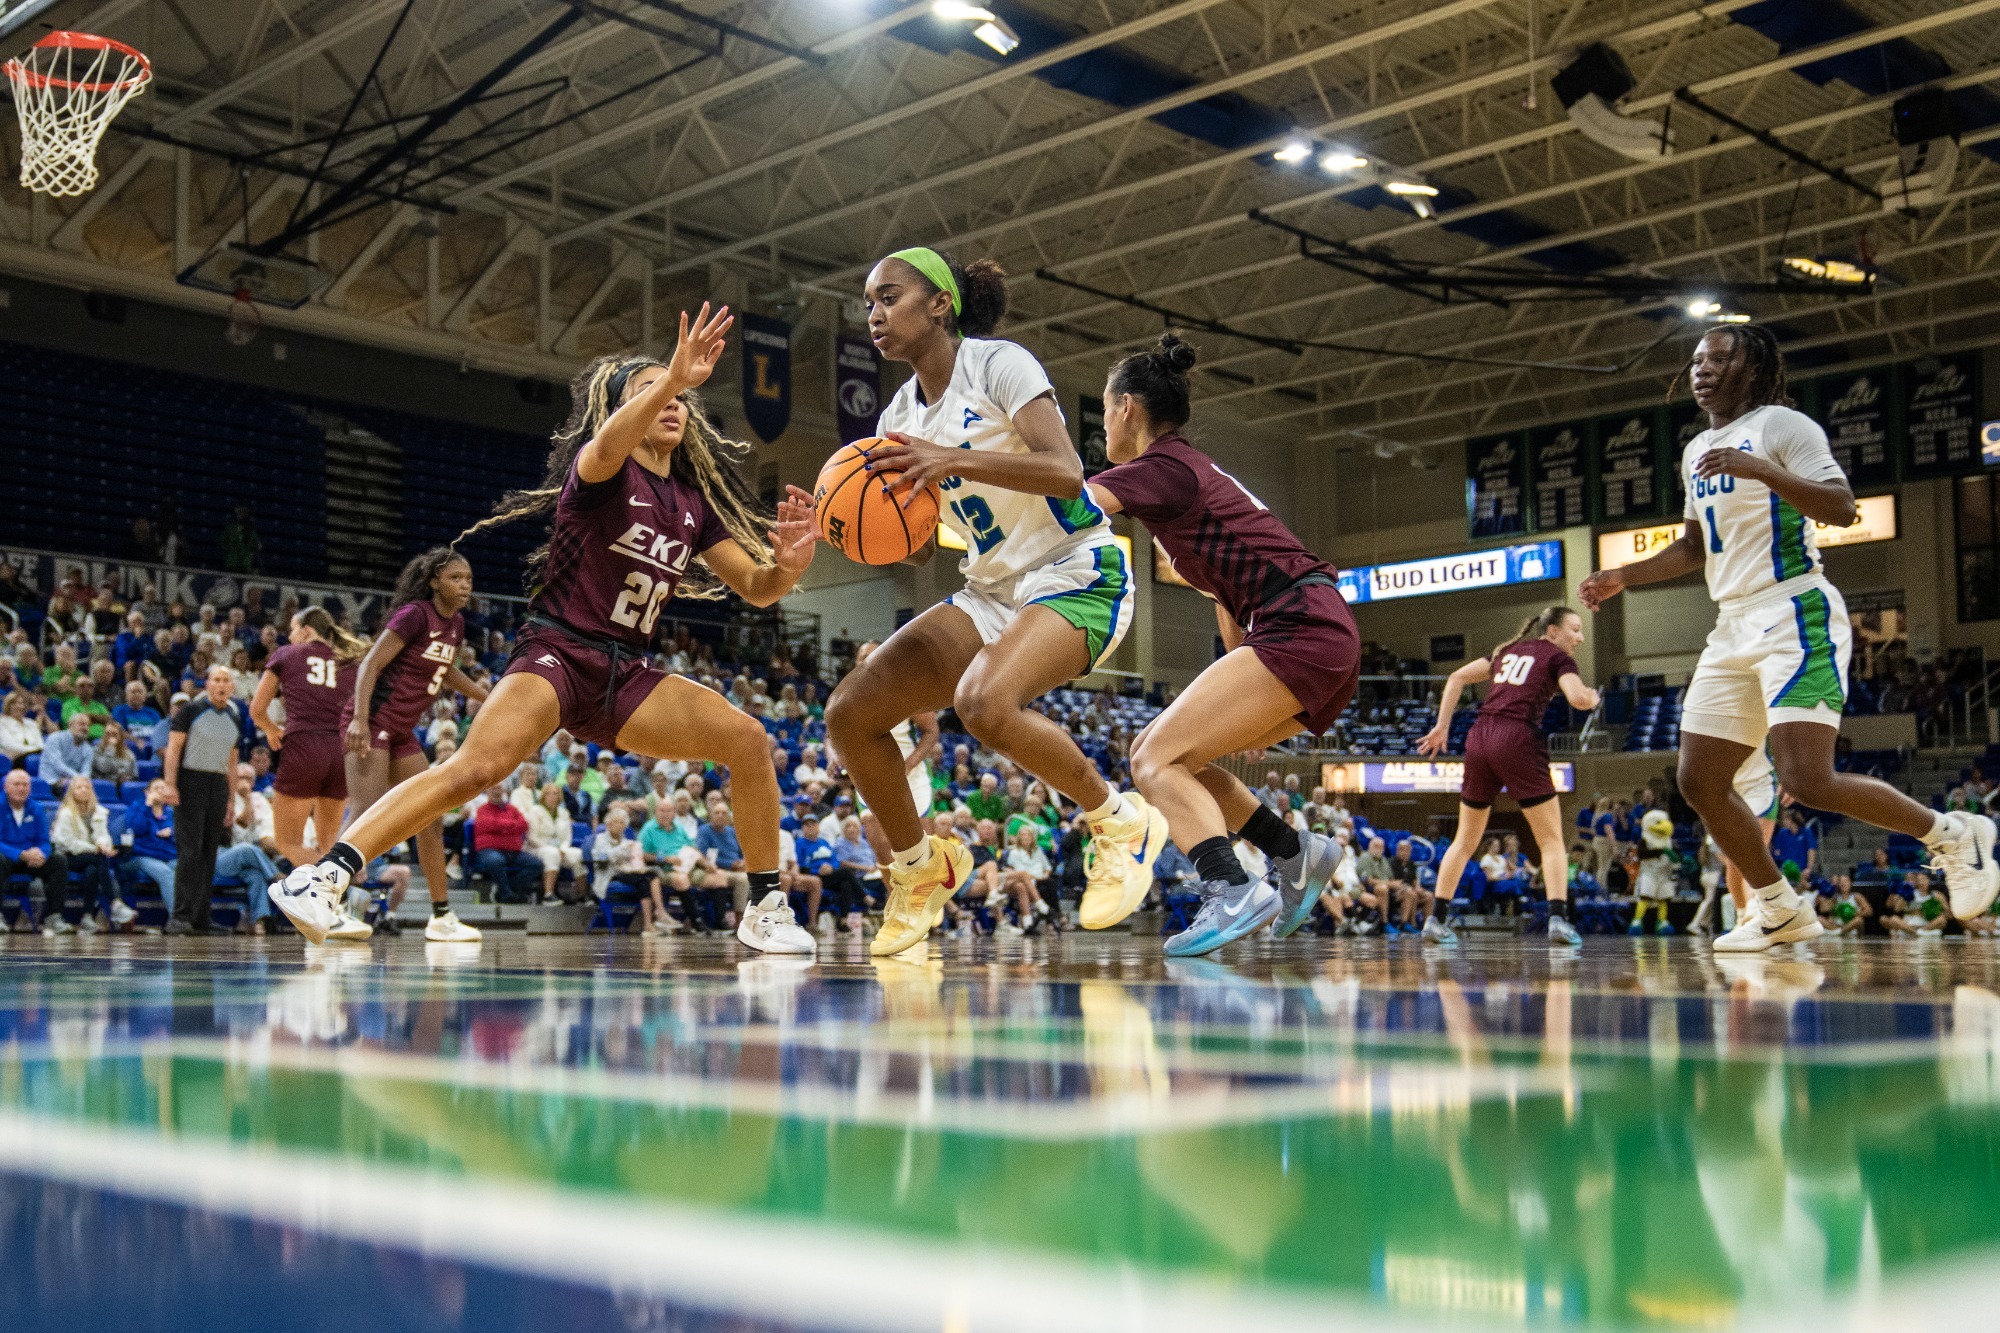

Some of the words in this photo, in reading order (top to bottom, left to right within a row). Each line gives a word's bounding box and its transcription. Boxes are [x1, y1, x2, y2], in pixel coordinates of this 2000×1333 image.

[753, 353, 780, 399] L
[614, 522, 693, 573] EKU
[1705, 505, 1724, 554] 1
[1376, 569, 1424, 591] BUD
[1430, 558, 1499, 584] LIGHT
[609, 570, 669, 634] 20
[306, 656, 337, 689] 31
[427, 665, 448, 696] 5
[1493, 653, 1536, 687] 30
